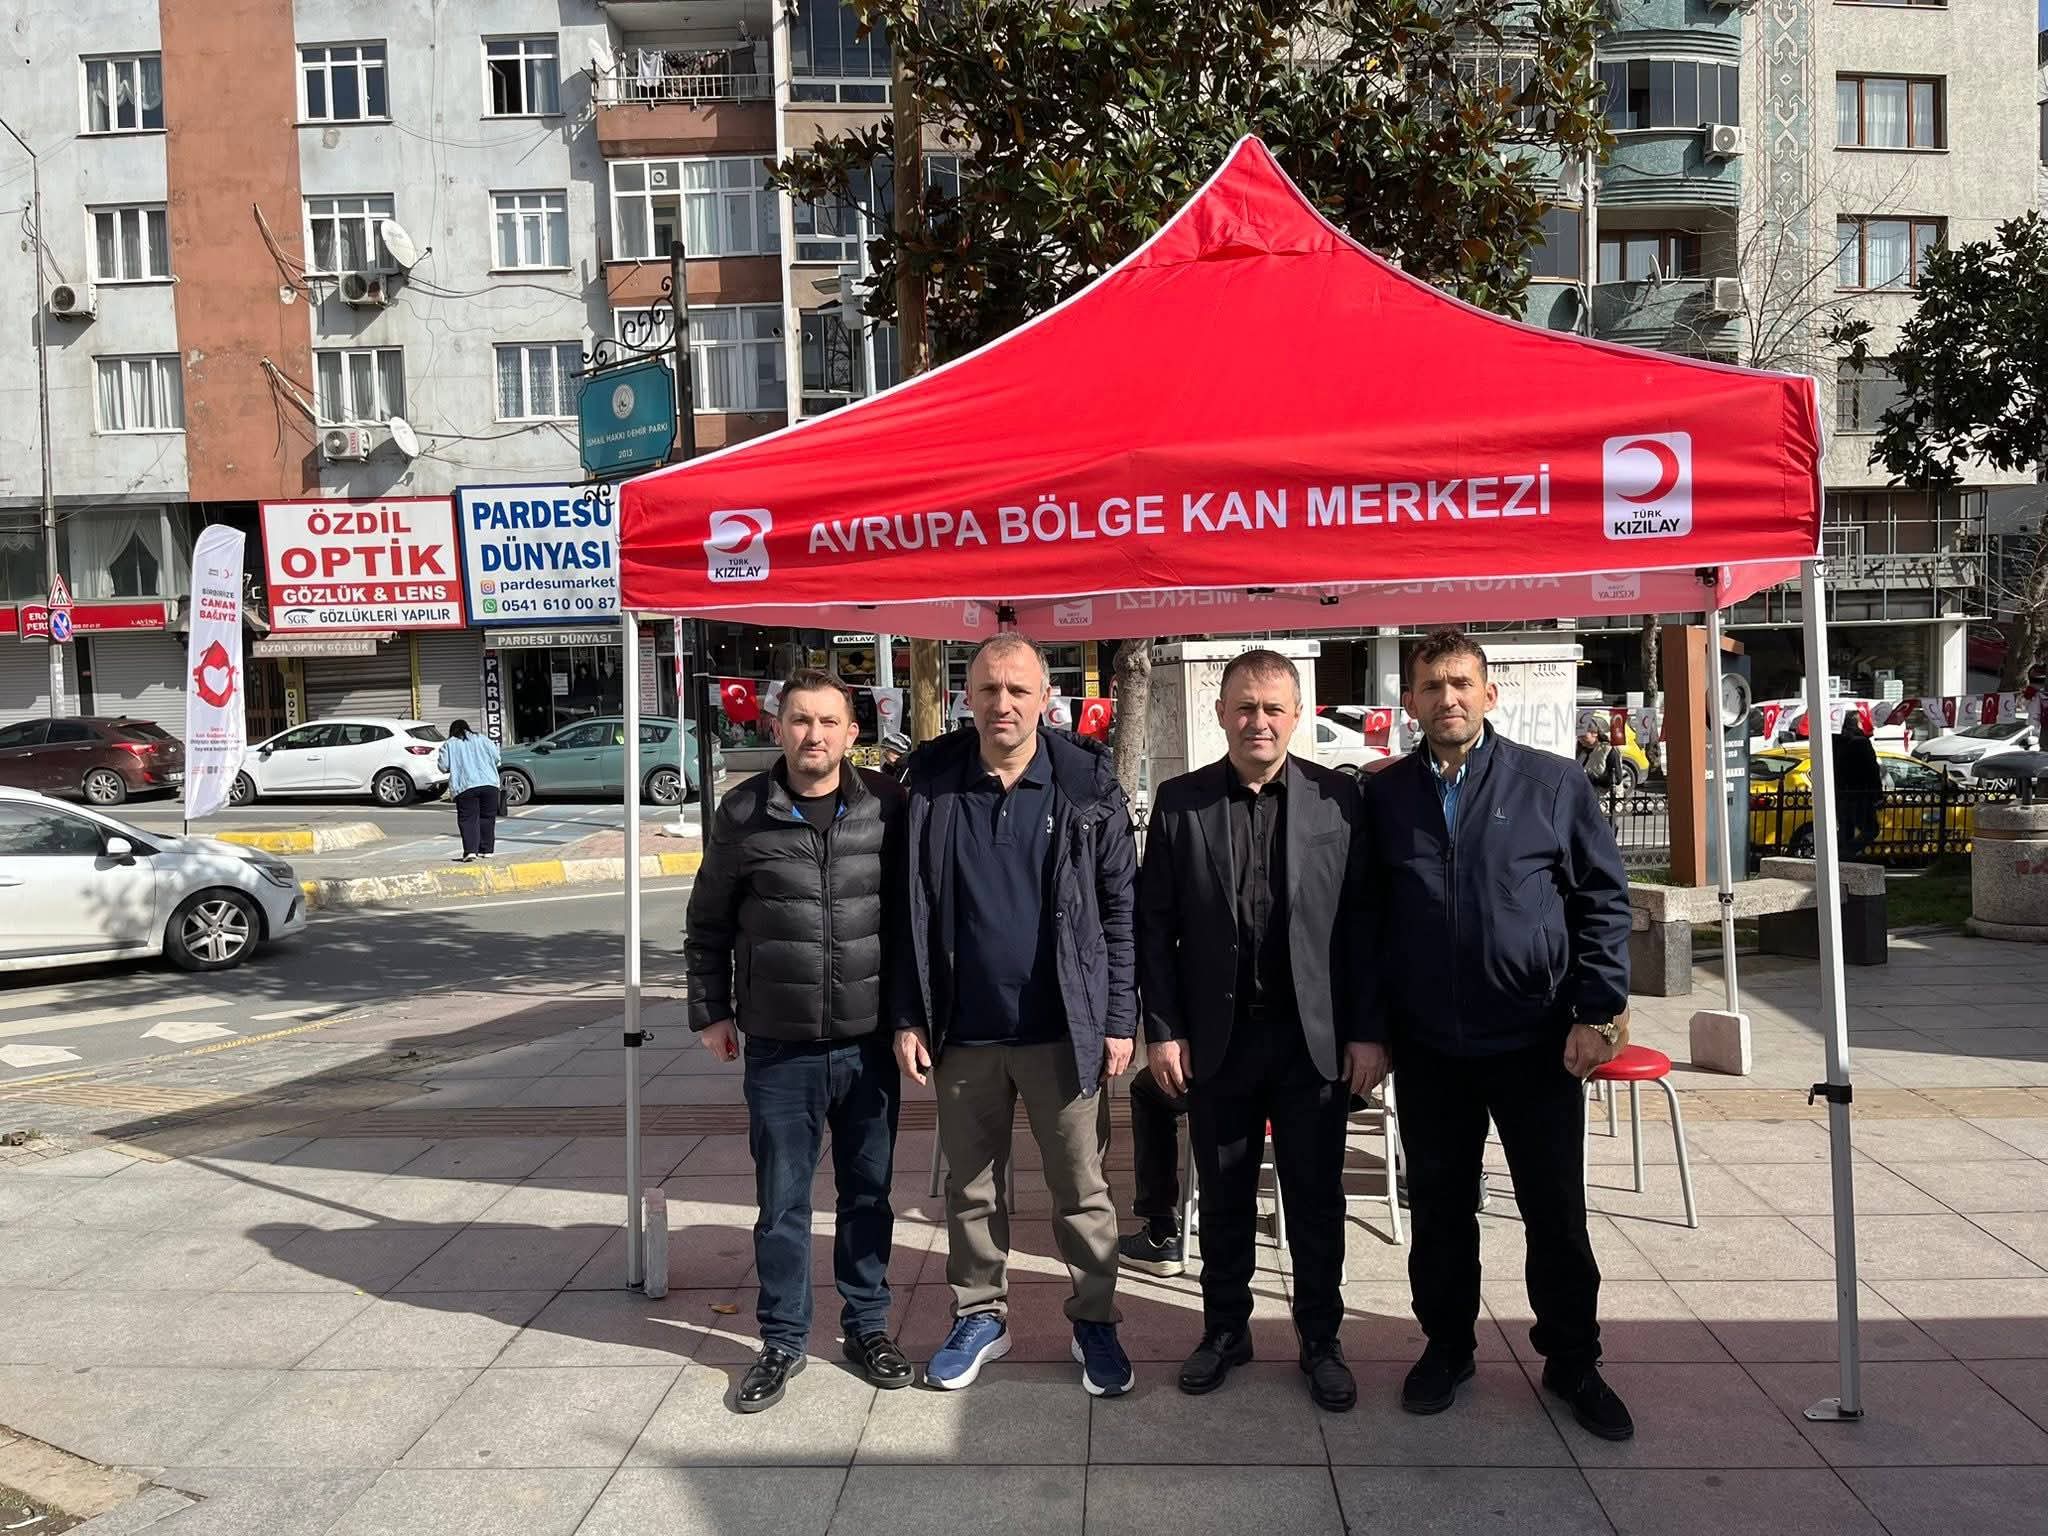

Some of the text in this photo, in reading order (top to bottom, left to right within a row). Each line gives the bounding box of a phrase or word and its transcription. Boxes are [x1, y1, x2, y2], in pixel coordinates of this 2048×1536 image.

[808, 463, 1550, 554] AVRUPA BÖLGE KAN MERKEZİ
[1633, 509, 1662, 519] TÜRK
[307, 506, 412, 535] ÖZDİL
[1614, 518, 1680, 535] KIZILAY
[281, 538, 446, 579] OPTİK
[480, 535, 611, 572] DÜNYASI
[729, 558, 749, 566] TÜRK
[715, 566, 761, 578] KIZILAY
[500, 576, 616, 593] pardesumarket
[282, 585, 448, 604] GÖZLÜK & LENS
[502, 597, 616, 612] 0541 610 00 87
[287, 608, 450, 625] SGK GÖZLÜKLERİ YAPILIR
[560, 632, 612, 645] DÜNYASI
